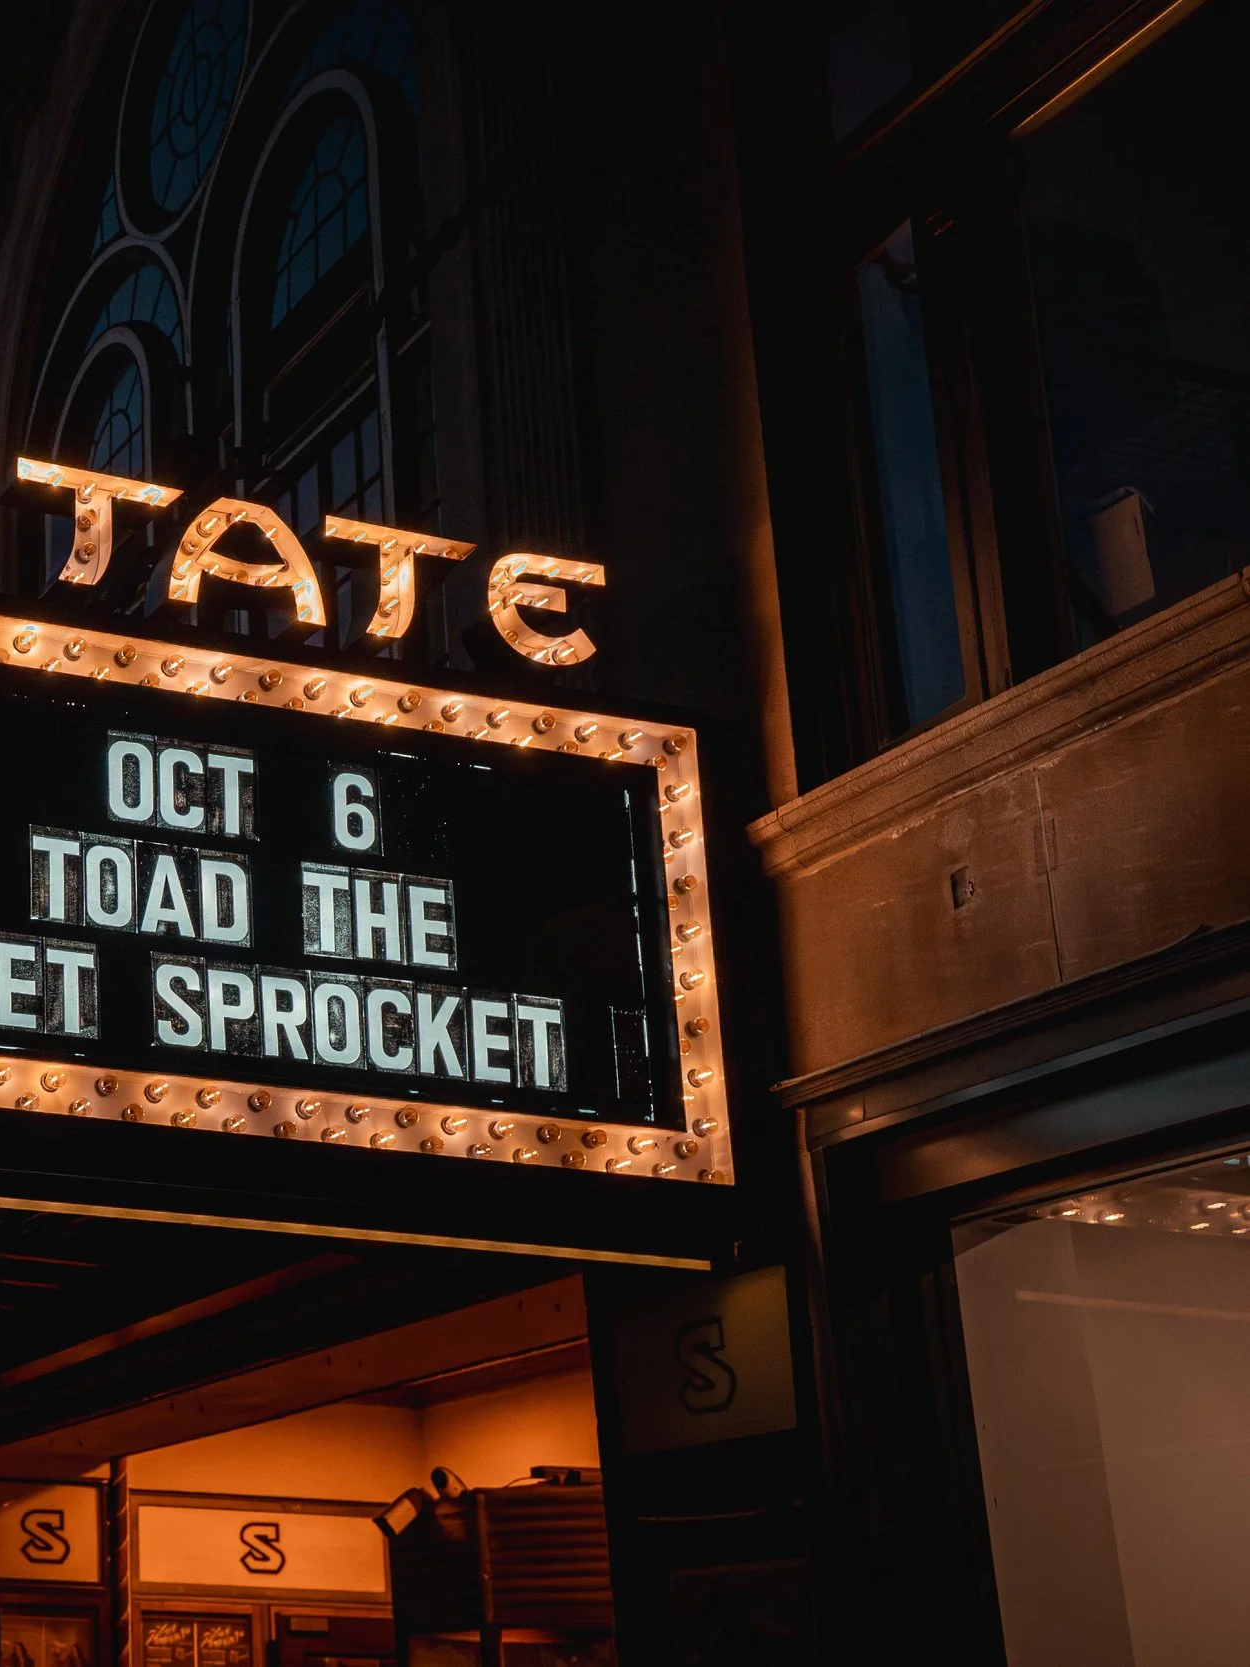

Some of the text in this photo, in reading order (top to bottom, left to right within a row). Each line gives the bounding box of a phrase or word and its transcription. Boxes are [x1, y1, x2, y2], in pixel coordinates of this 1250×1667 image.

[107, 739, 376, 852] OCT 6
[31, 834, 450, 968] TOAD THE
[155, 963, 562, 1087] SPROCKET
[675, 1315, 737, 1415] S
[20, 1508, 70, 1565] S
[239, 1522, 285, 1574] S
